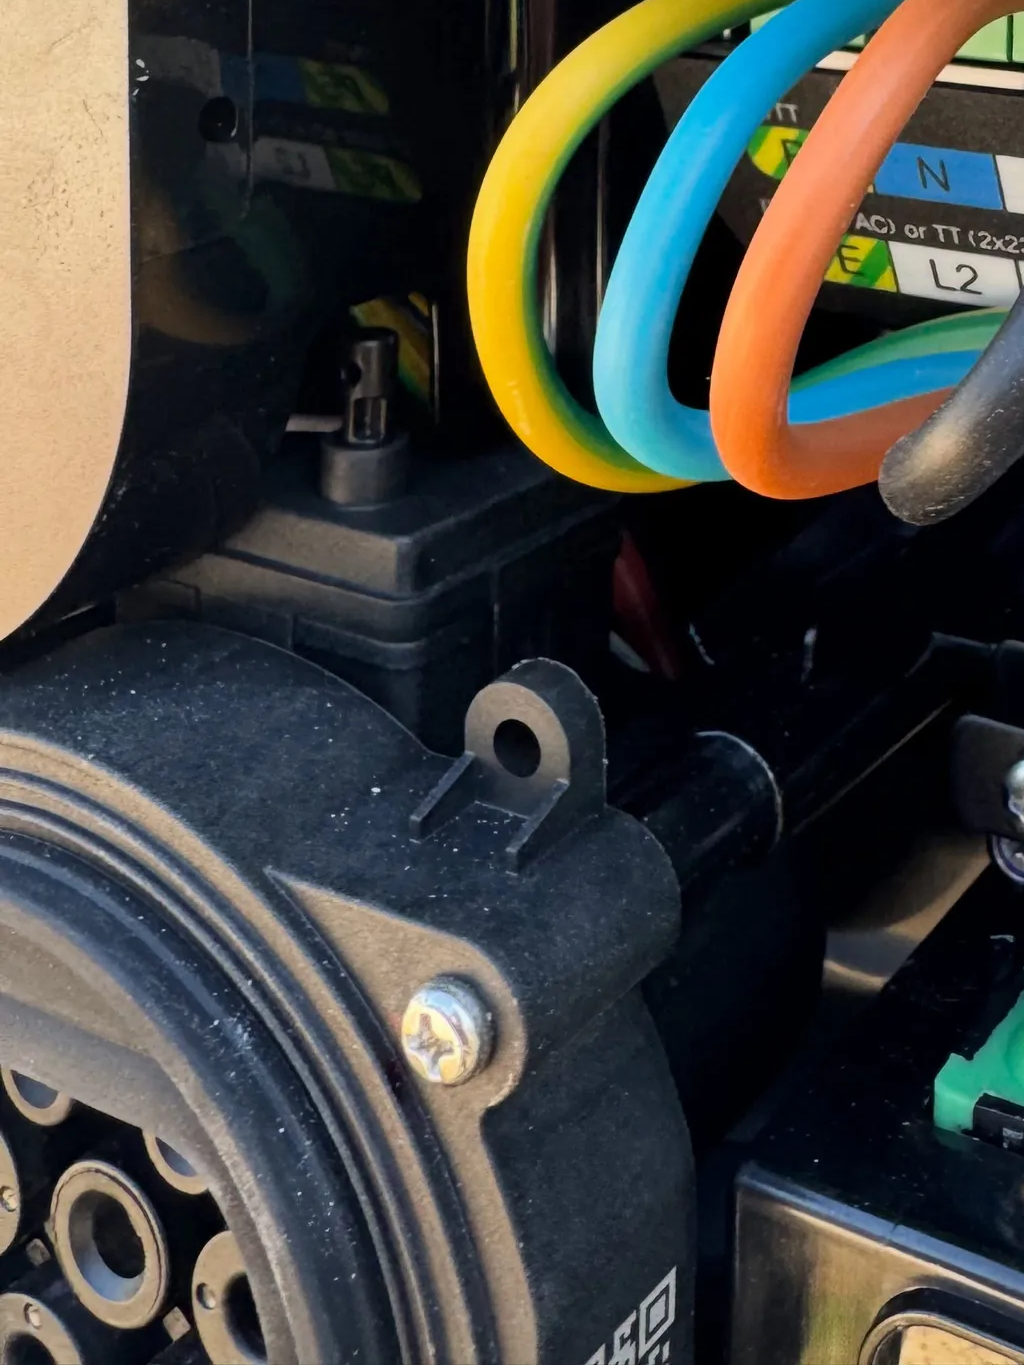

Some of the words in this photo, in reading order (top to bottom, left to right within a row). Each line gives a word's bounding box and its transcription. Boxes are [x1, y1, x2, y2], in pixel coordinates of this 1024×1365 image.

[917, 156, 951, 192] N
[855, 211, 896, 234] AC)
[904, 224, 926, 239] or
[932, 224, 961, 244] TT
[929, 258, 982, 295] L2
